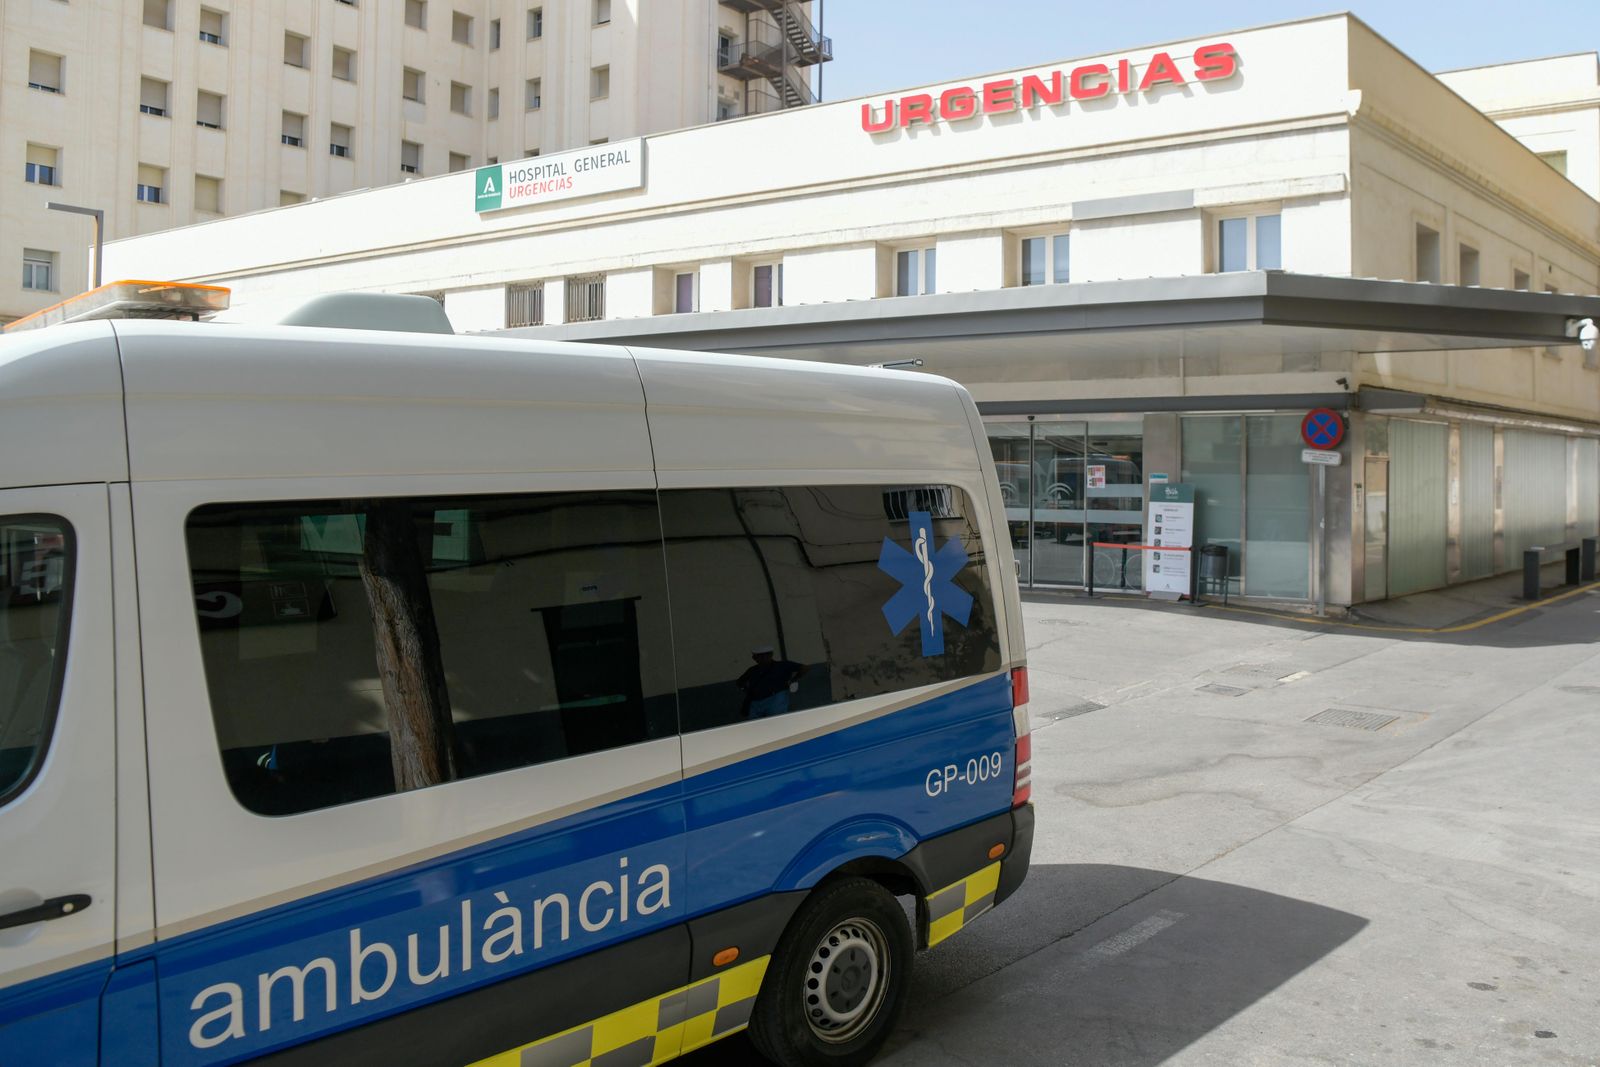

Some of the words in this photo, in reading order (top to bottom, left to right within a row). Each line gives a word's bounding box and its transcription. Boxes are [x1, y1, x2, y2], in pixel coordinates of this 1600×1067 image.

[861, 42, 1236, 133] URGENCIAS
[509, 162, 567, 184] HOSPITAL
[574, 149, 631, 173] GENERAL
[509, 176, 573, 199] URGENCIAS
[925, 751, 1002, 797] GP-009
[188, 856, 672, 1049] ambulància
